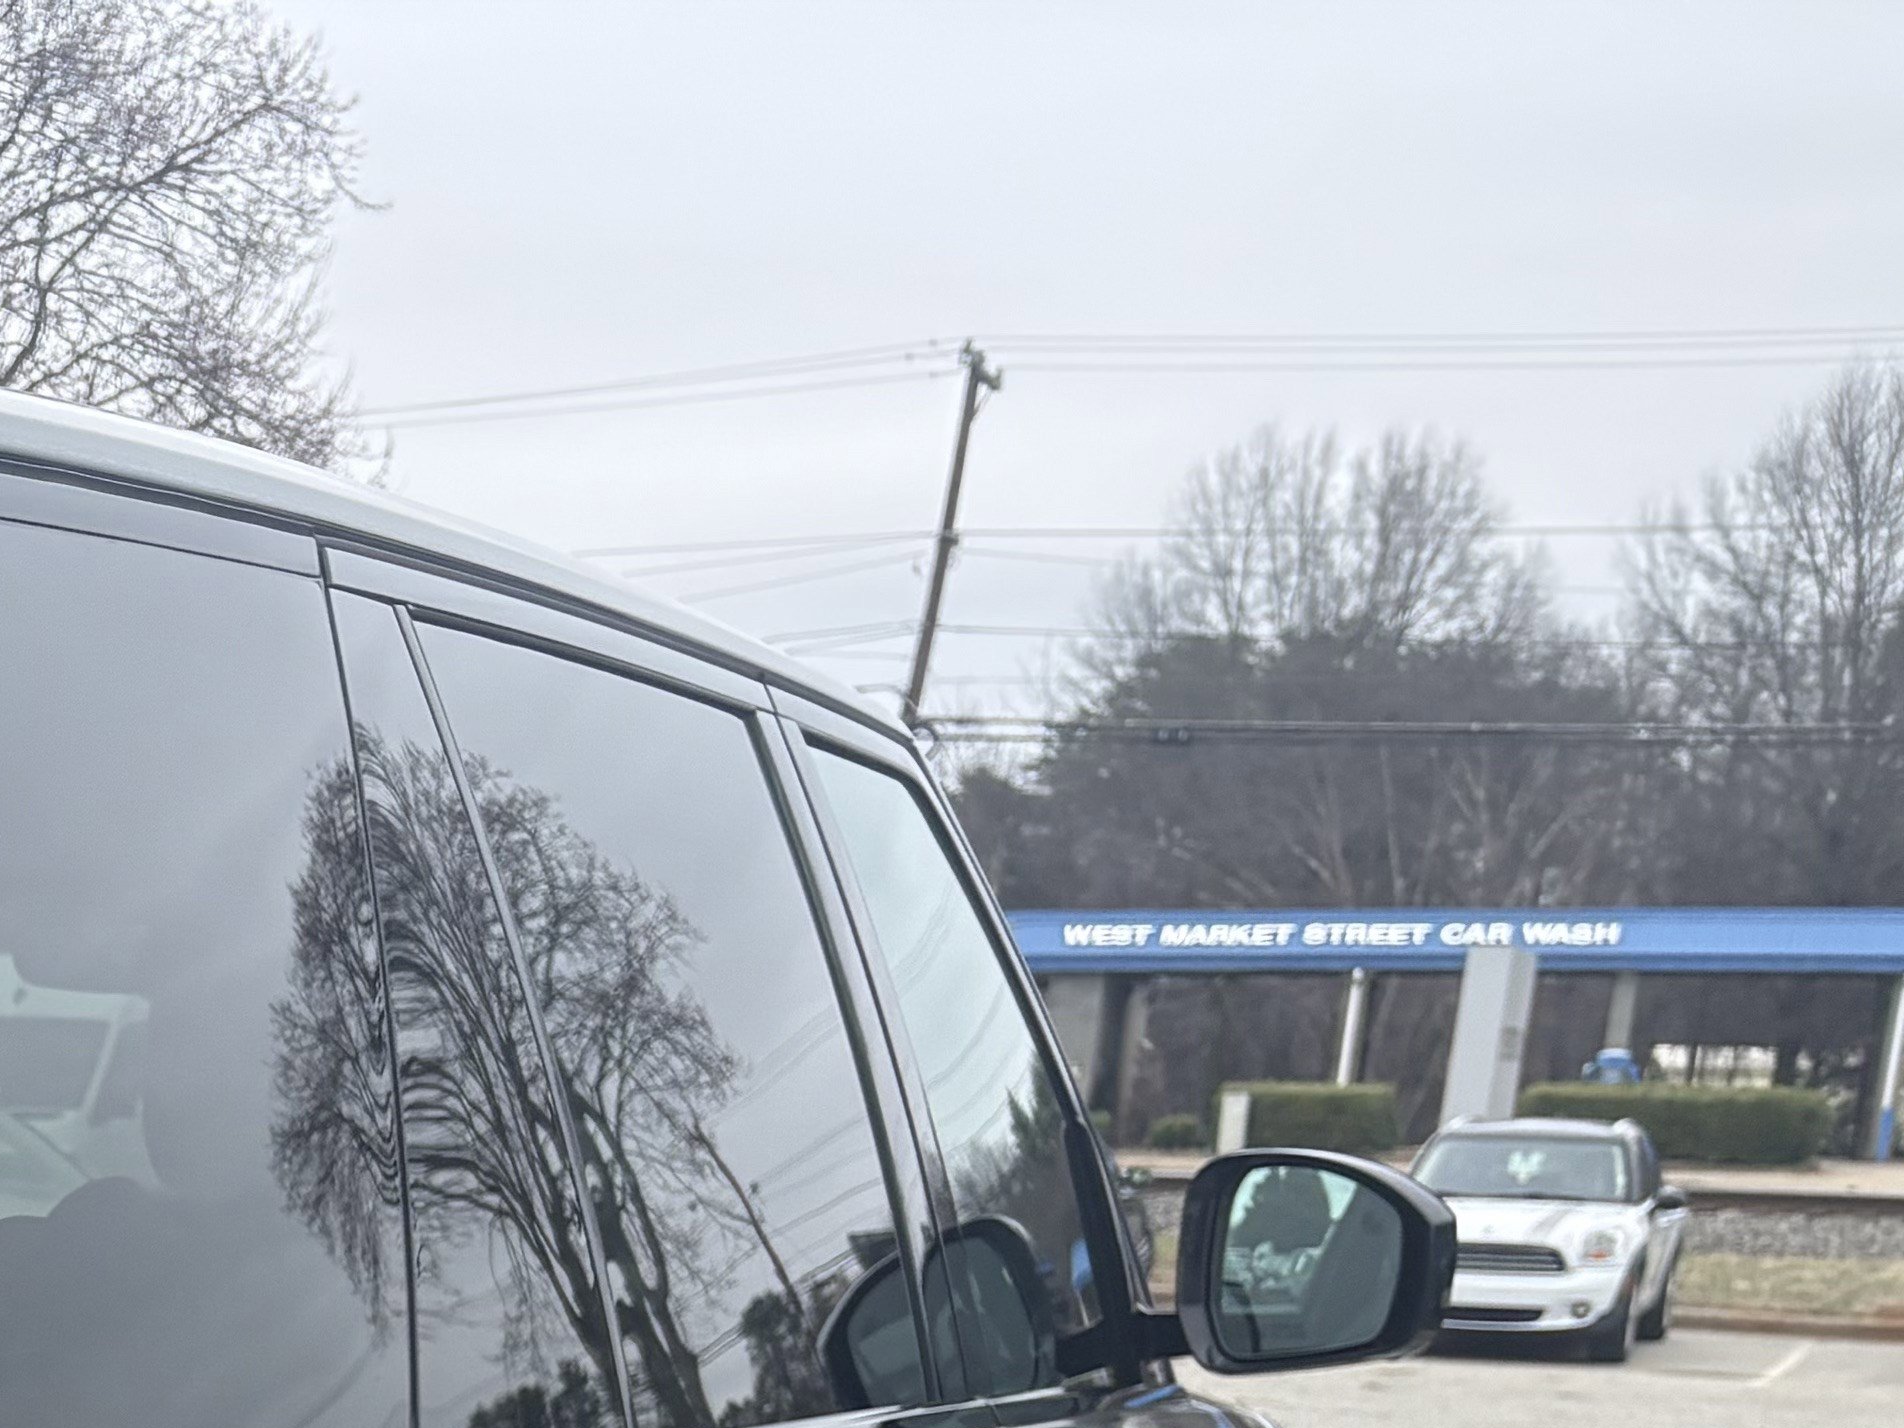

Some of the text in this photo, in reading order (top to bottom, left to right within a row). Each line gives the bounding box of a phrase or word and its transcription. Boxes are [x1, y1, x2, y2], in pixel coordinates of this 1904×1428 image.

[1064, 922, 1622, 946] WEST MARKET STREET CAR WASH
